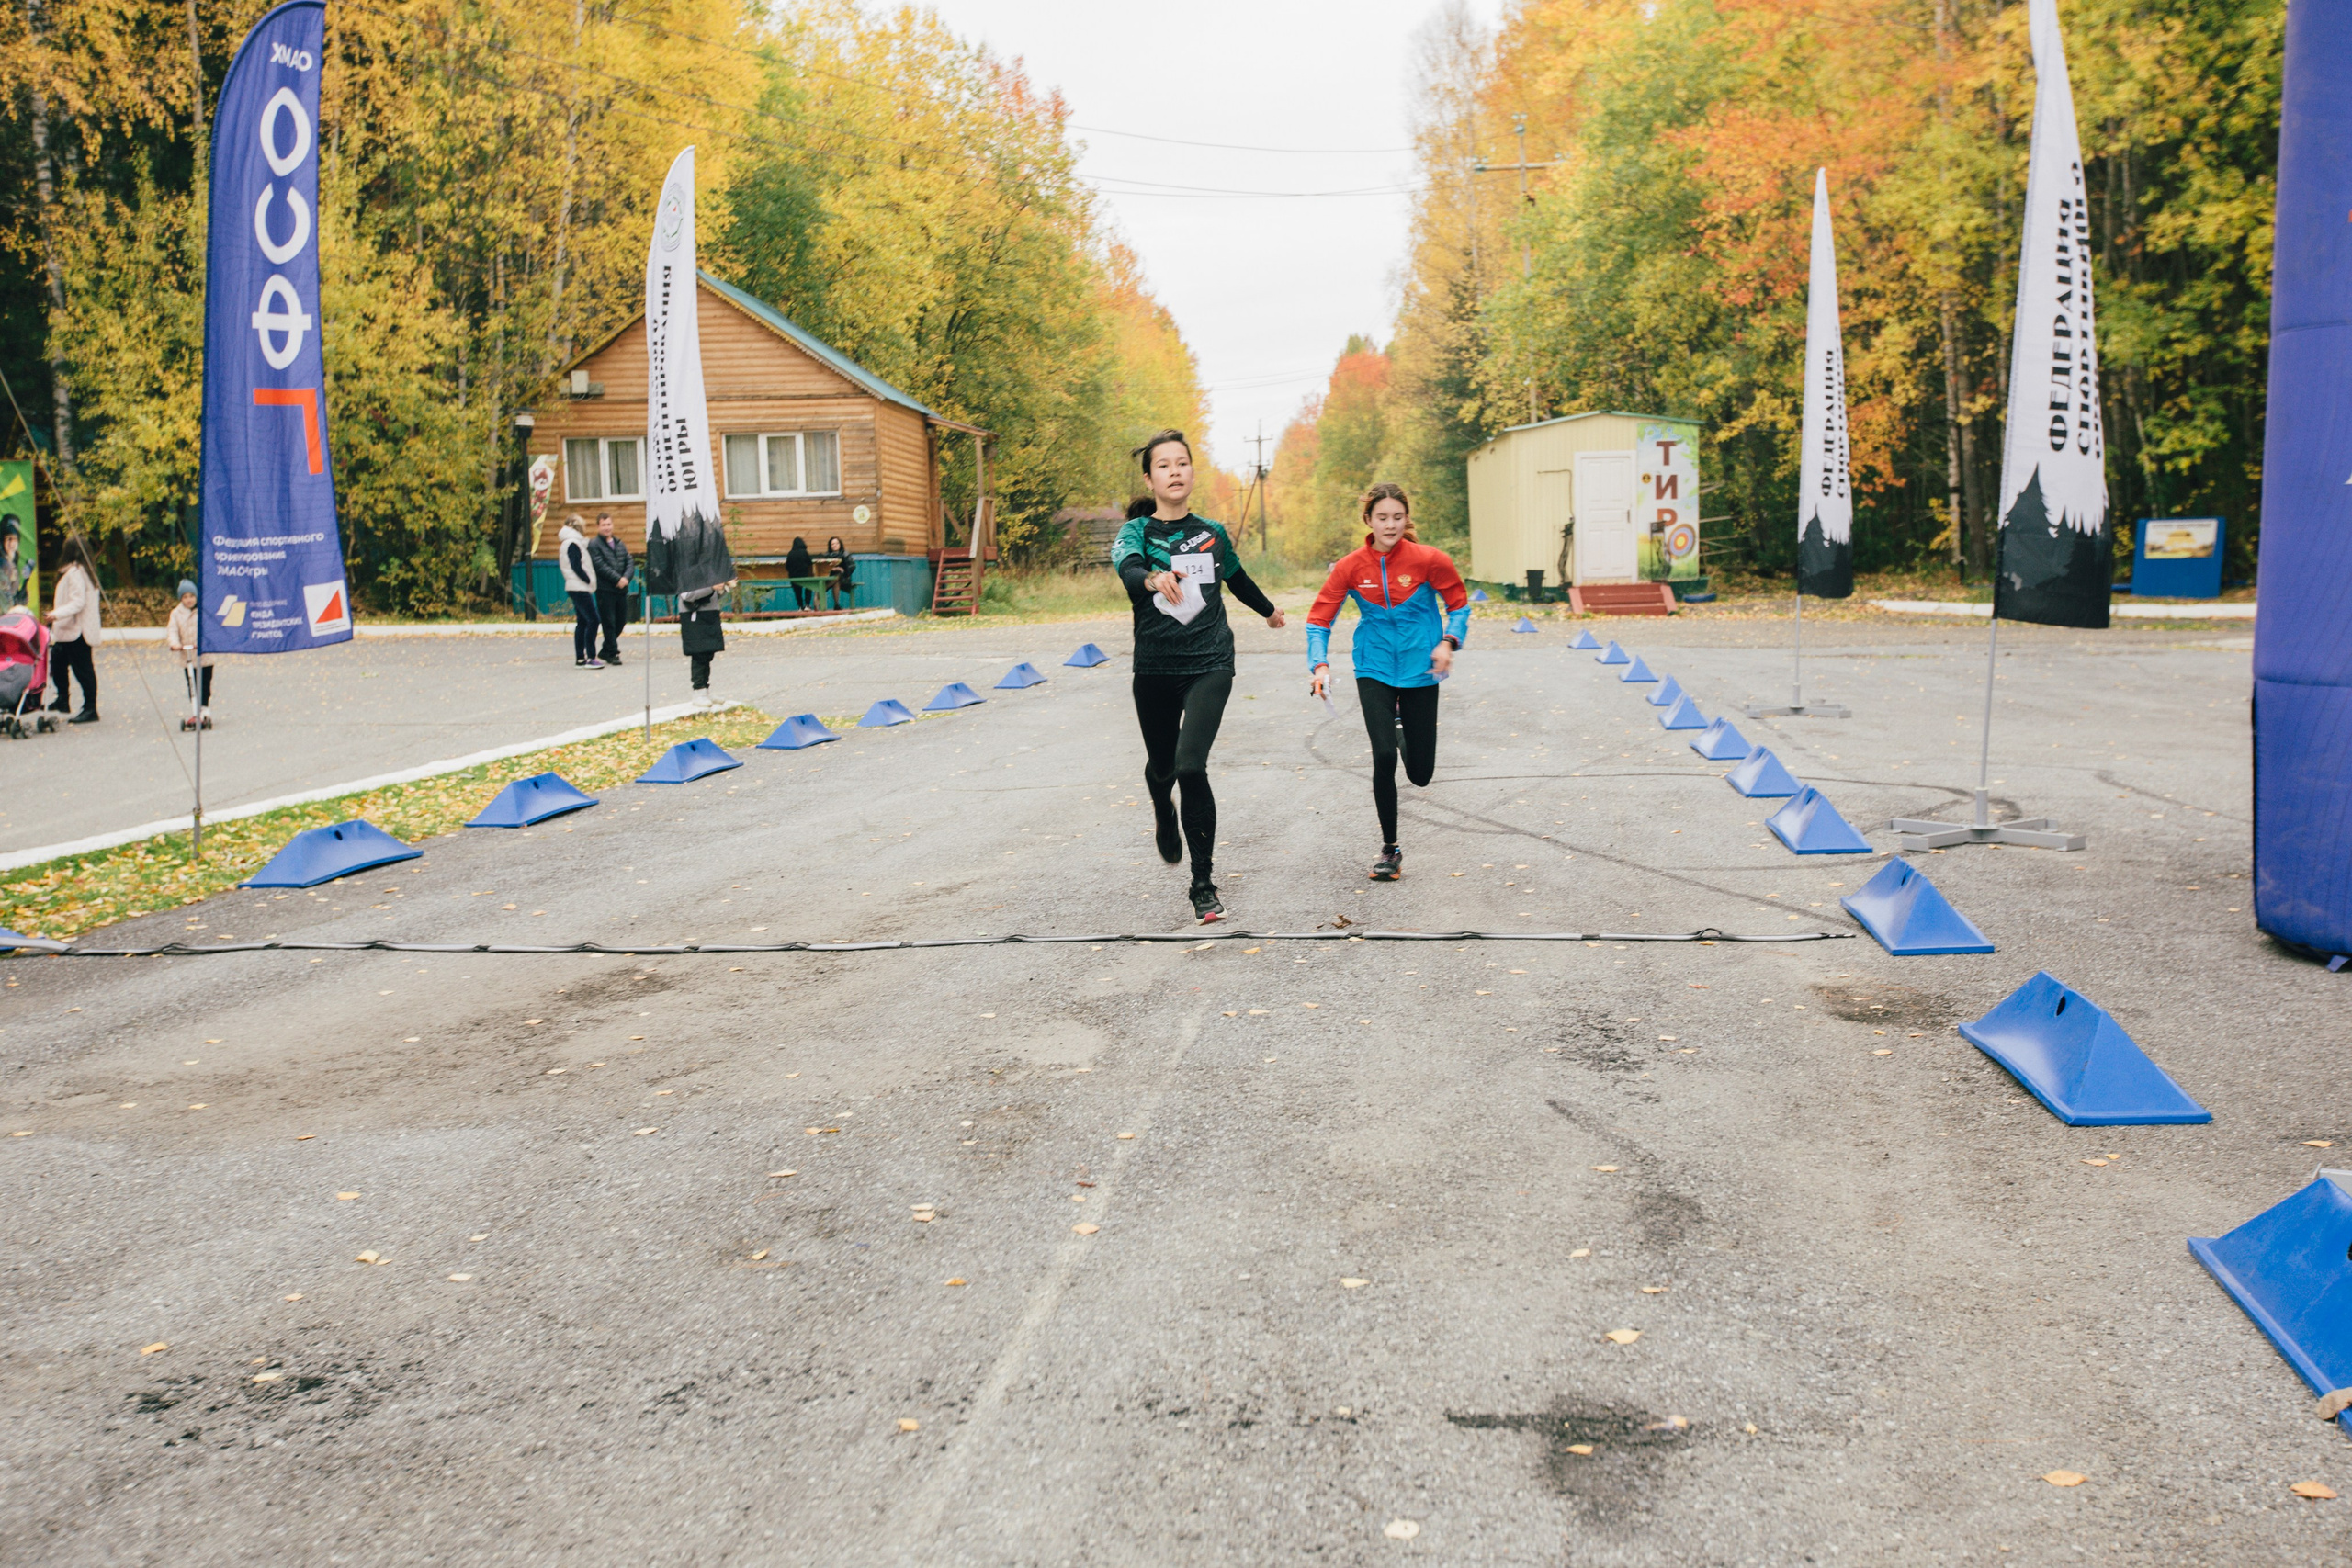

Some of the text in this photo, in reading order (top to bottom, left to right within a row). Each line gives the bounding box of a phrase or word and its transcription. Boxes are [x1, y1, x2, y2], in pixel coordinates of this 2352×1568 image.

[270, 41, 313, 72] ХМАО
[2048, 198, 2074, 453] ФЕДЕРАЦИЯ
[675, 417, 698, 491] ЮГРЫ
[1820, 350, 1835, 498] ФЕДЕРАЦИЯ
[1656, 440, 1679, 527] ТИР
[1185, 564, 1203, 575] 124
